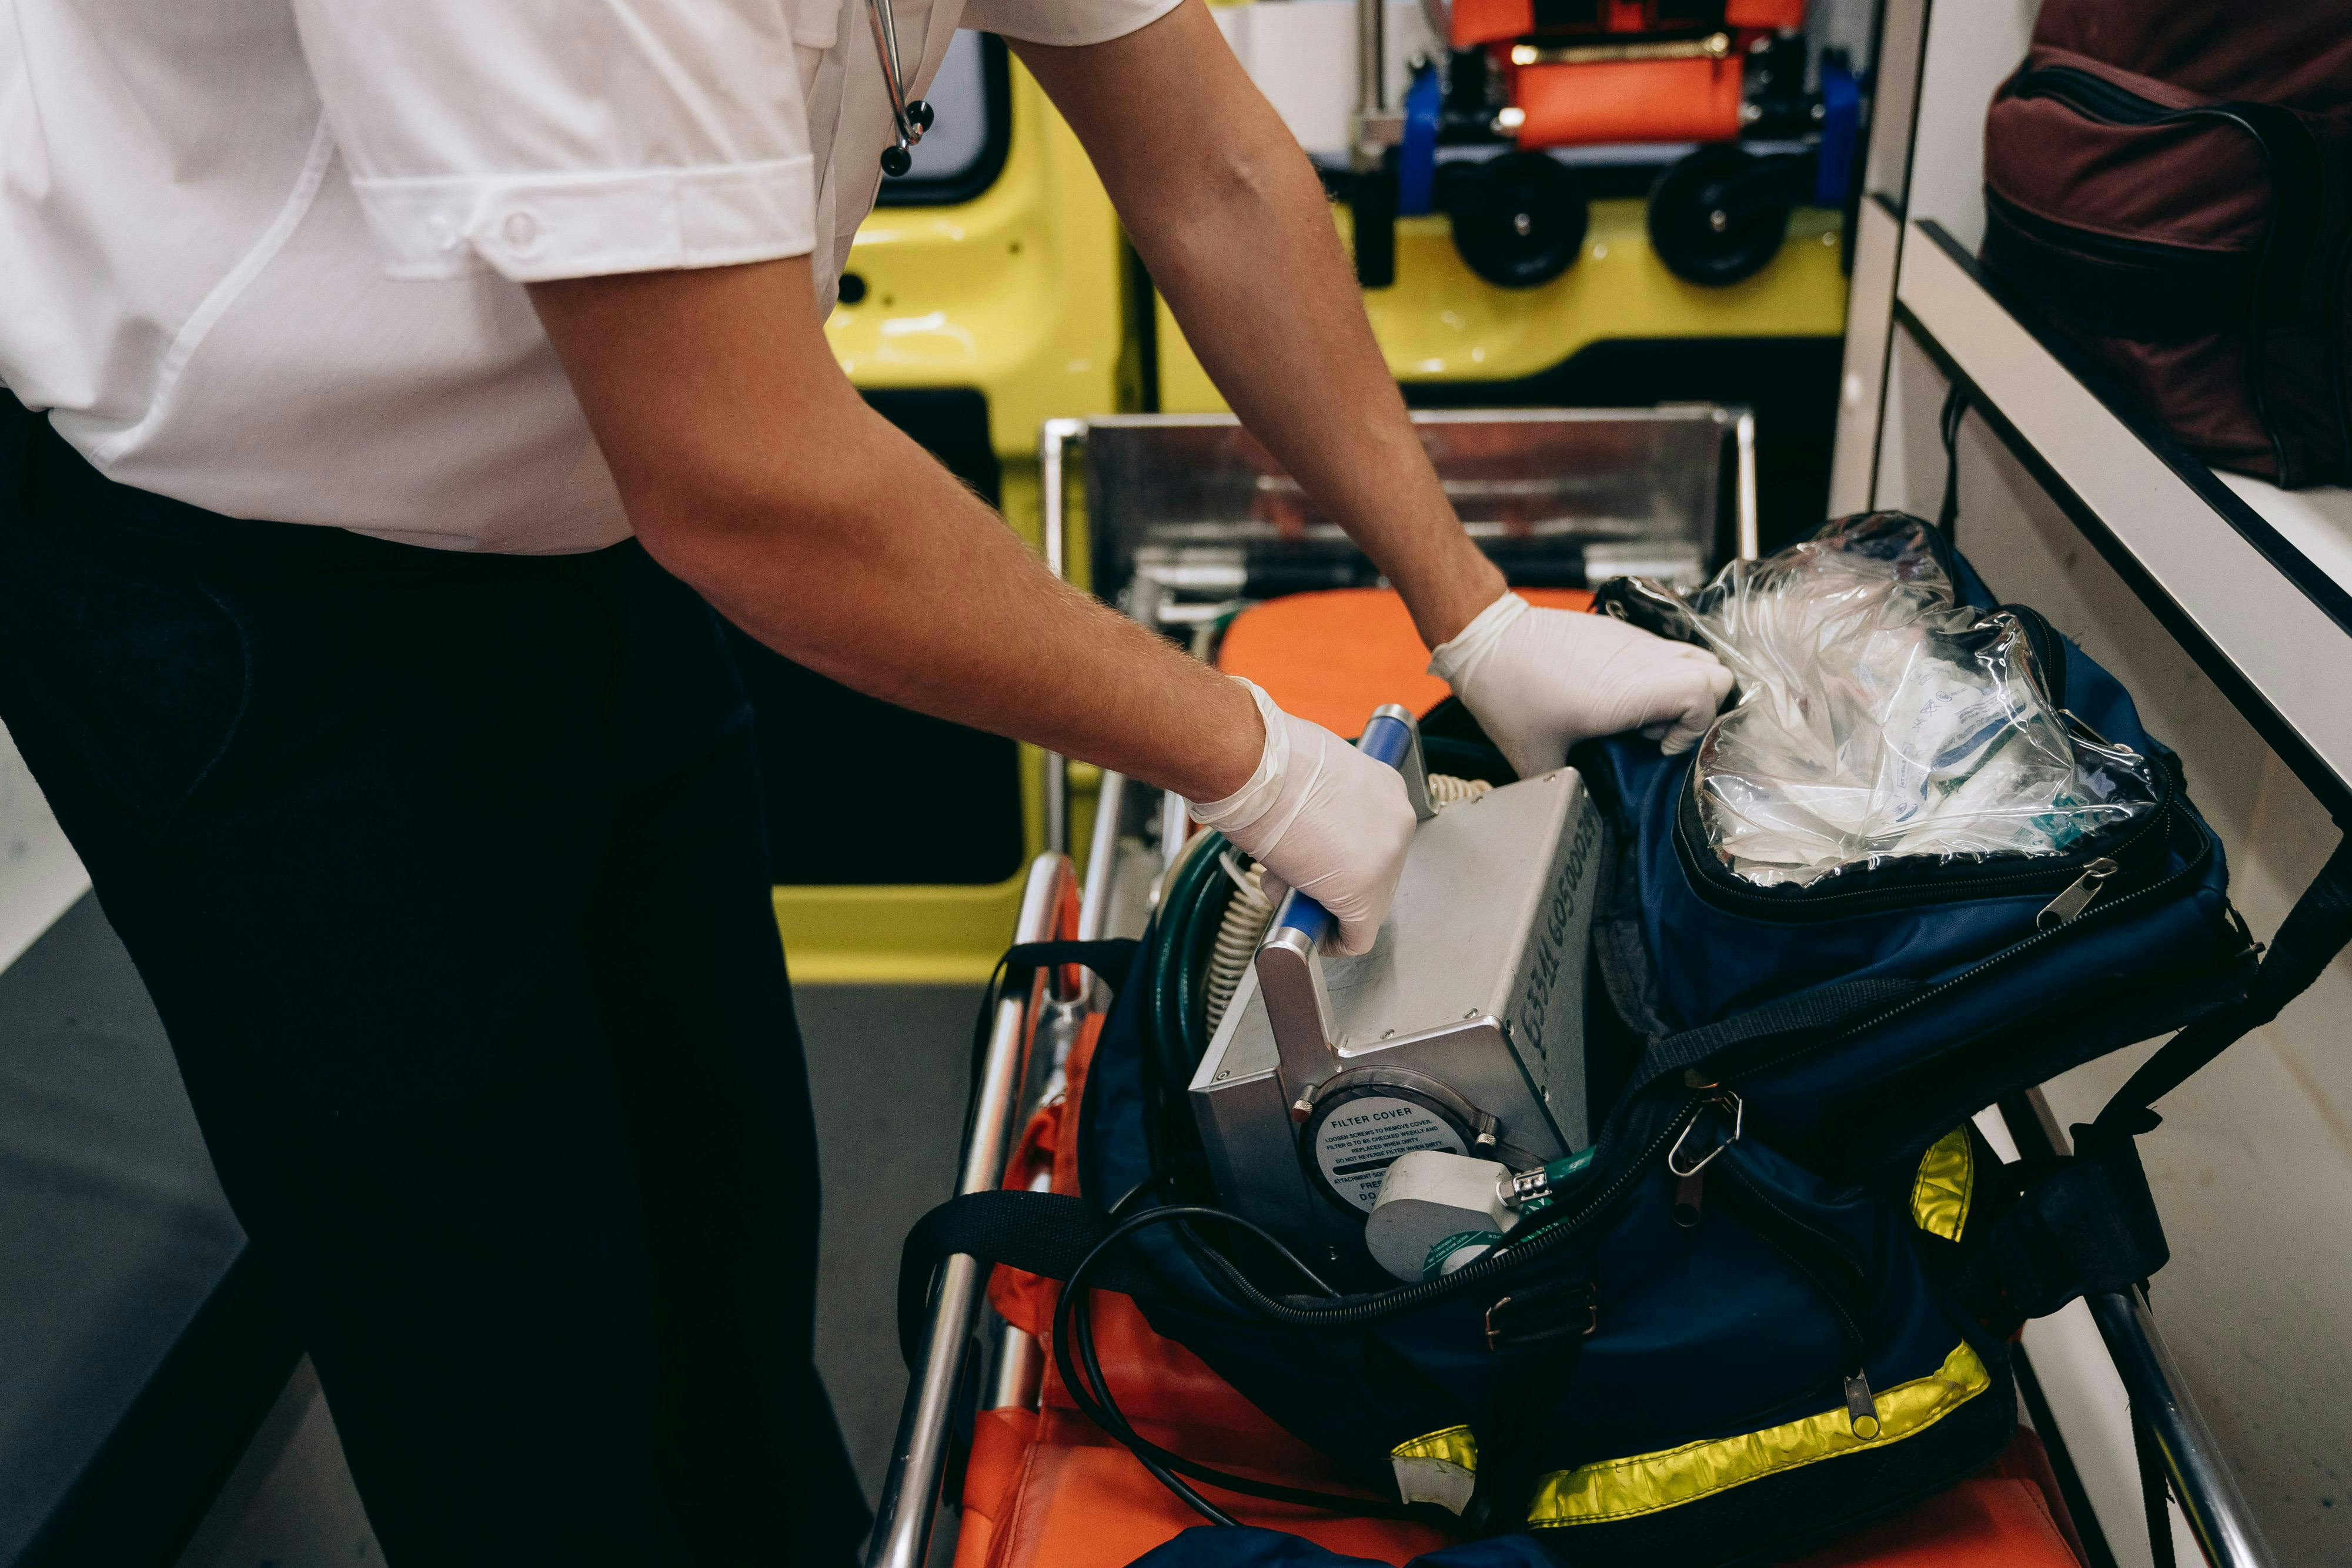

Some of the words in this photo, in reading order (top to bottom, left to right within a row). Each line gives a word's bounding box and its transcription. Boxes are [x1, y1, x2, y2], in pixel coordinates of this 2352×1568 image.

[1331, 1115, 1370, 1129] FILTER
[1373, 1107, 1412, 1121] COVER
[1325, 1135, 1349, 1143] LOOSEN
[1349, 1130, 1375, 1139] SCREWS
[1384, 1123, 1409, 1132] REMOVE
[1410, 1119, 1433, 1128] COVER.
[1327, 1142, 1347, 1151] FILTER
[1372, 1132, 1400, 1142] CHECKED
[1400, 1128, 1425, 1138] WEEKLY
[1351, 1144, 1382, 1154] REPLACED
[1358, 1151, 1385, 1161] REVERSE
[1386, 1147, 1406, 1155] FILTER
[1425, 1141, 1444, 1149] DIRTY.
[1334, 1173, 1371, 1184] ATTACHMENT
[1359, 1192, 1376, 1201] DO
